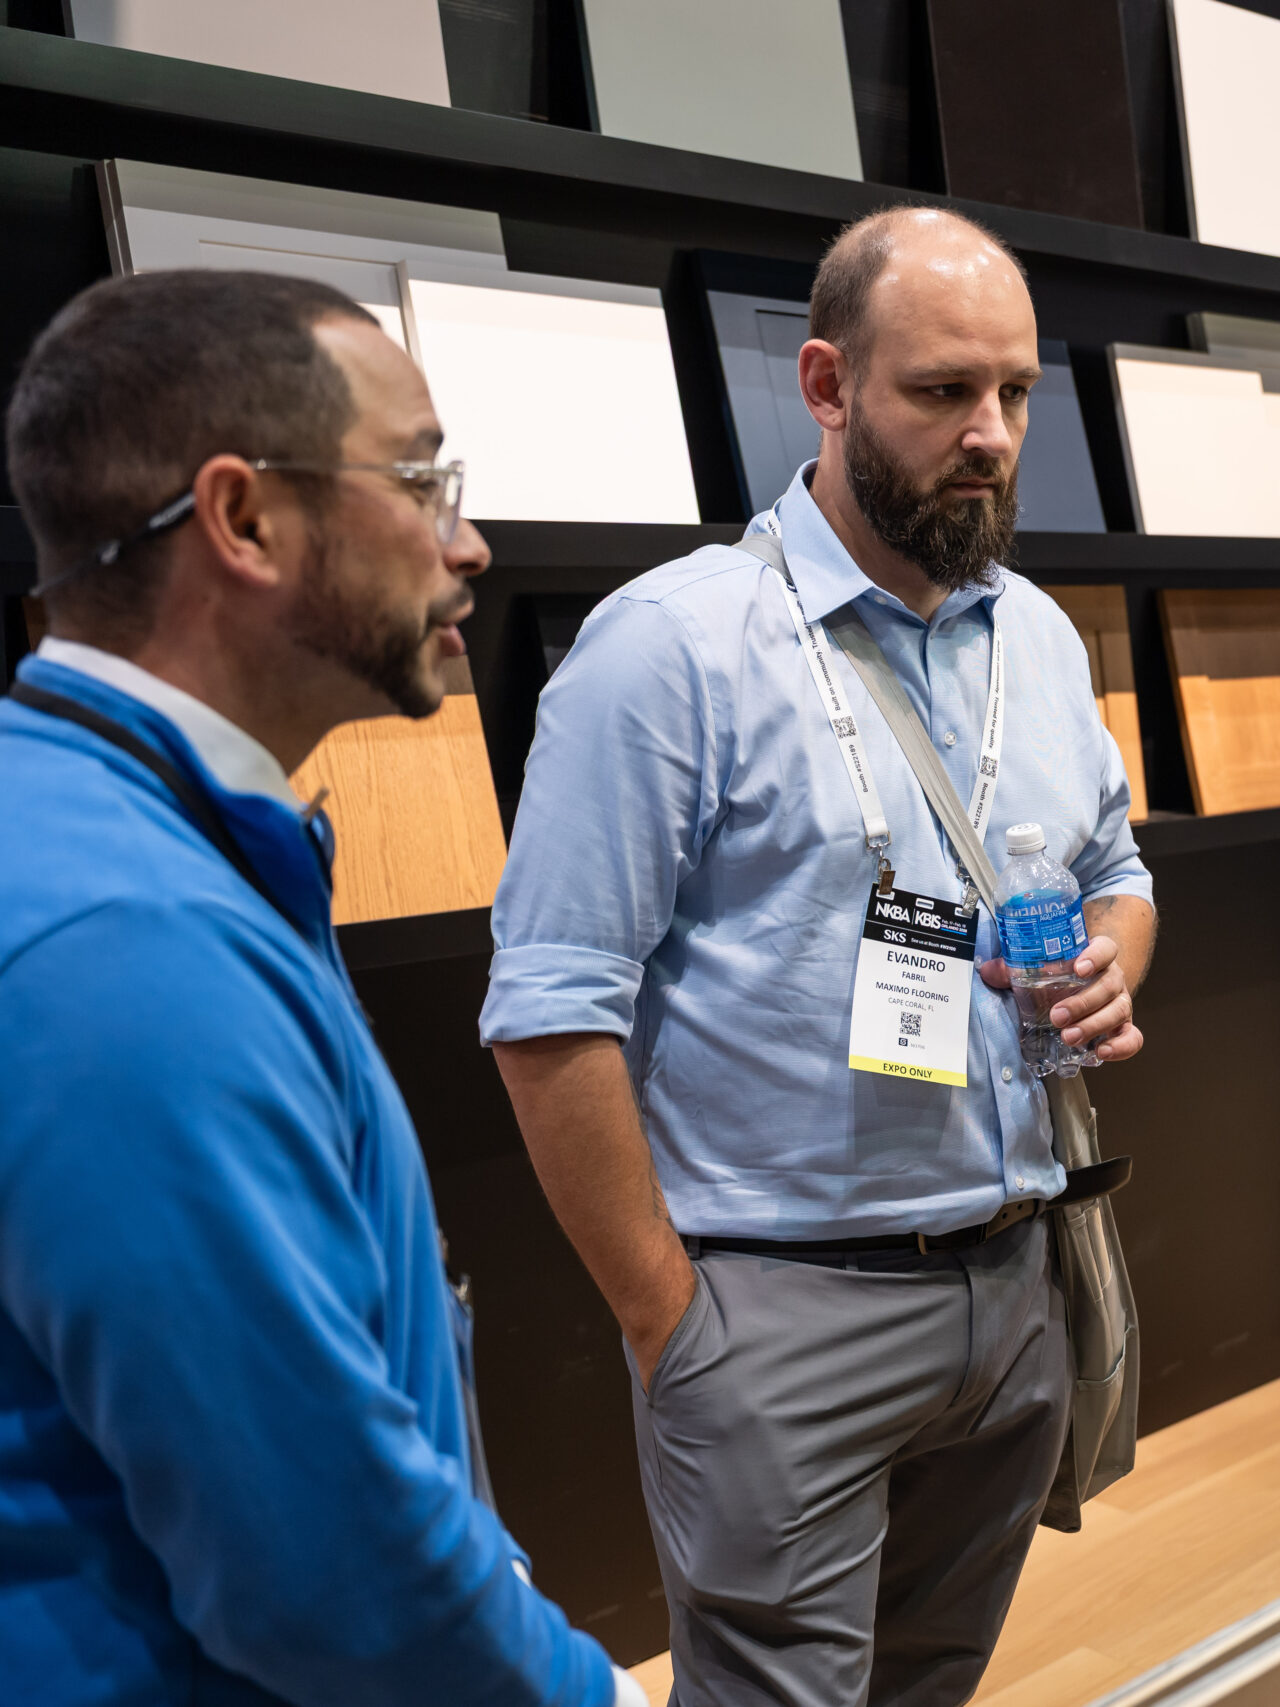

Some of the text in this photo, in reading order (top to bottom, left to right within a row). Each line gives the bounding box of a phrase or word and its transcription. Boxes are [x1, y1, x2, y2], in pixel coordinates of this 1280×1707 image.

[804, 624, 818, 650] Trusted
[828, 686, 836, 696] on
[832, 696, 840, 712] Built
[992, 696, 1000, 720] Trusted
[858, 774, 868, 792] Booth
[980, 782, 988, 800] Booth
[875, 902, 941, 929] NKBA KBIS
[884, 929, 907, 943] SKS
[886, 950, 946, 973] EVANDRO
[901, 971, 927, 983] FABRIL
[875, 981, 950, 1003] MAXIMO FLOORING
[888, 997, 904, 1007] CAPE
[928, 1004, 934, 1012] FL
[883, 1062, 933, 1079] EXPO ONLY
